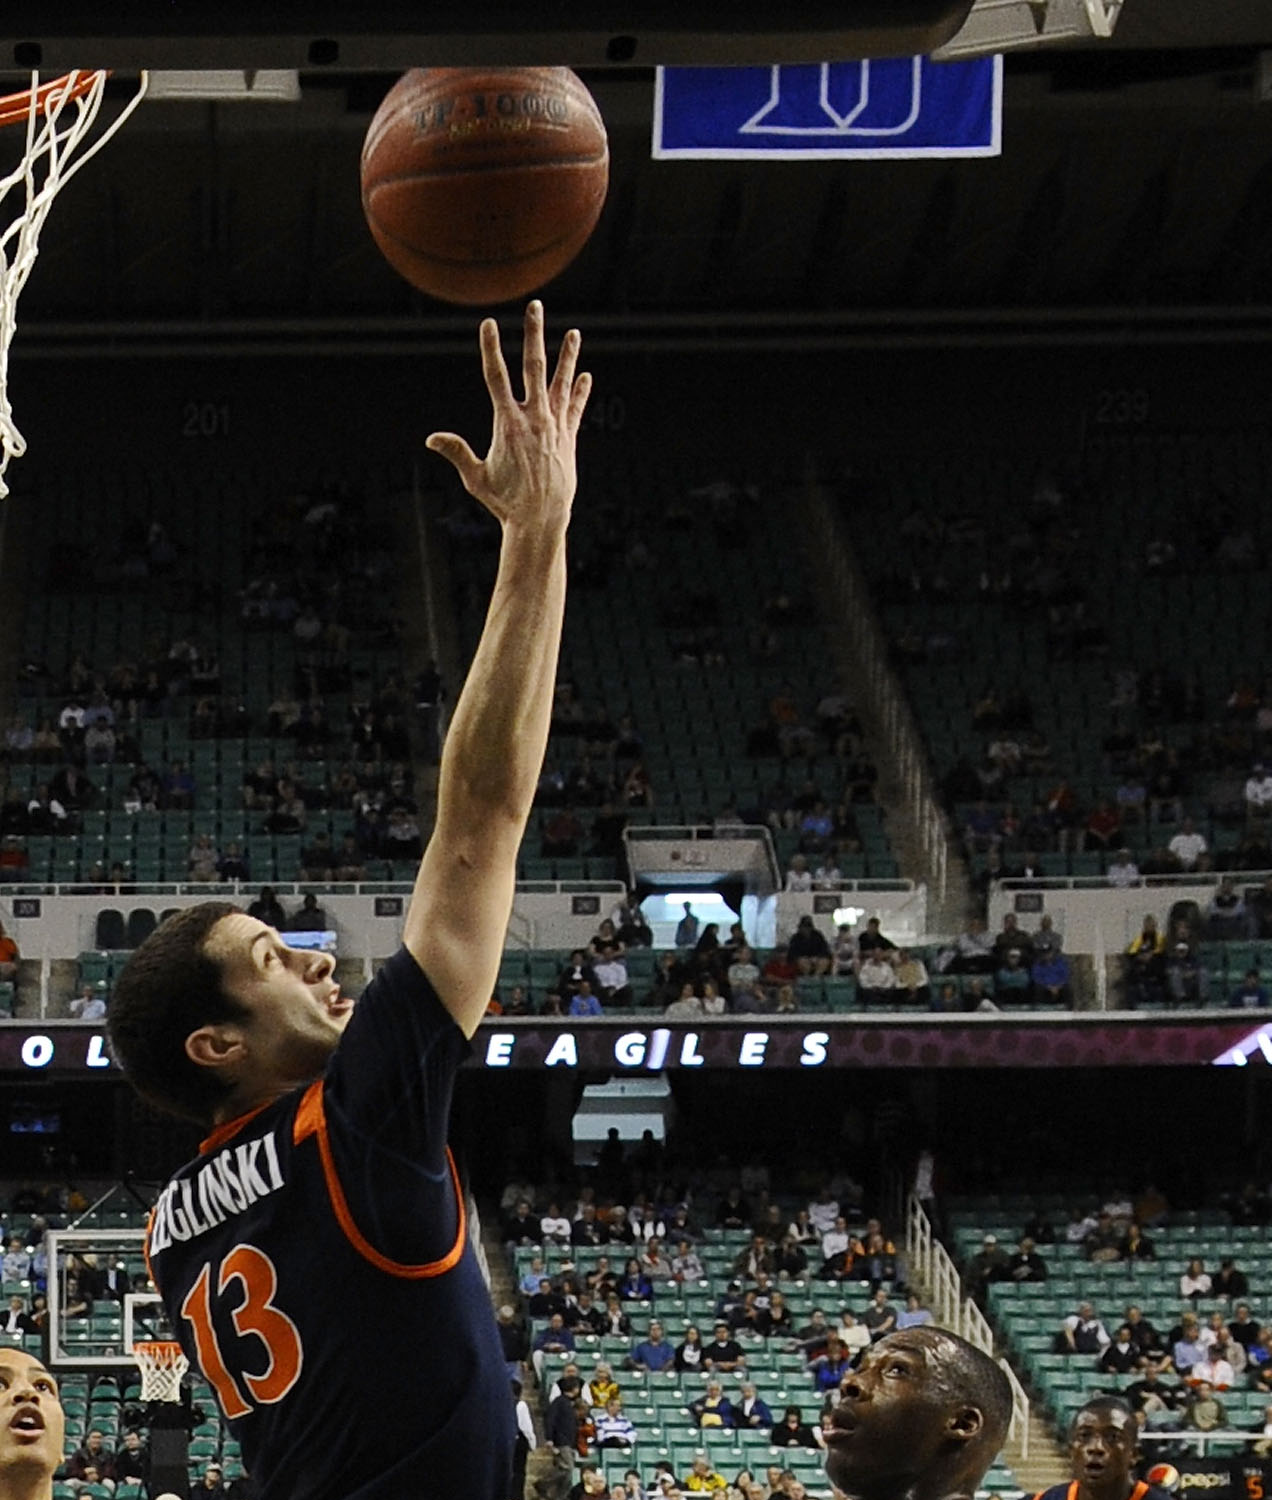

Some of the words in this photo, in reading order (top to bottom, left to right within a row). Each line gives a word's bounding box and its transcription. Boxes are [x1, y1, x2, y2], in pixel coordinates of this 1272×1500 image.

[588, 396, 625, 430] 40
[181, 1243, 304, 1419] 13
[1247, 1475, 1264, 1500] 5
